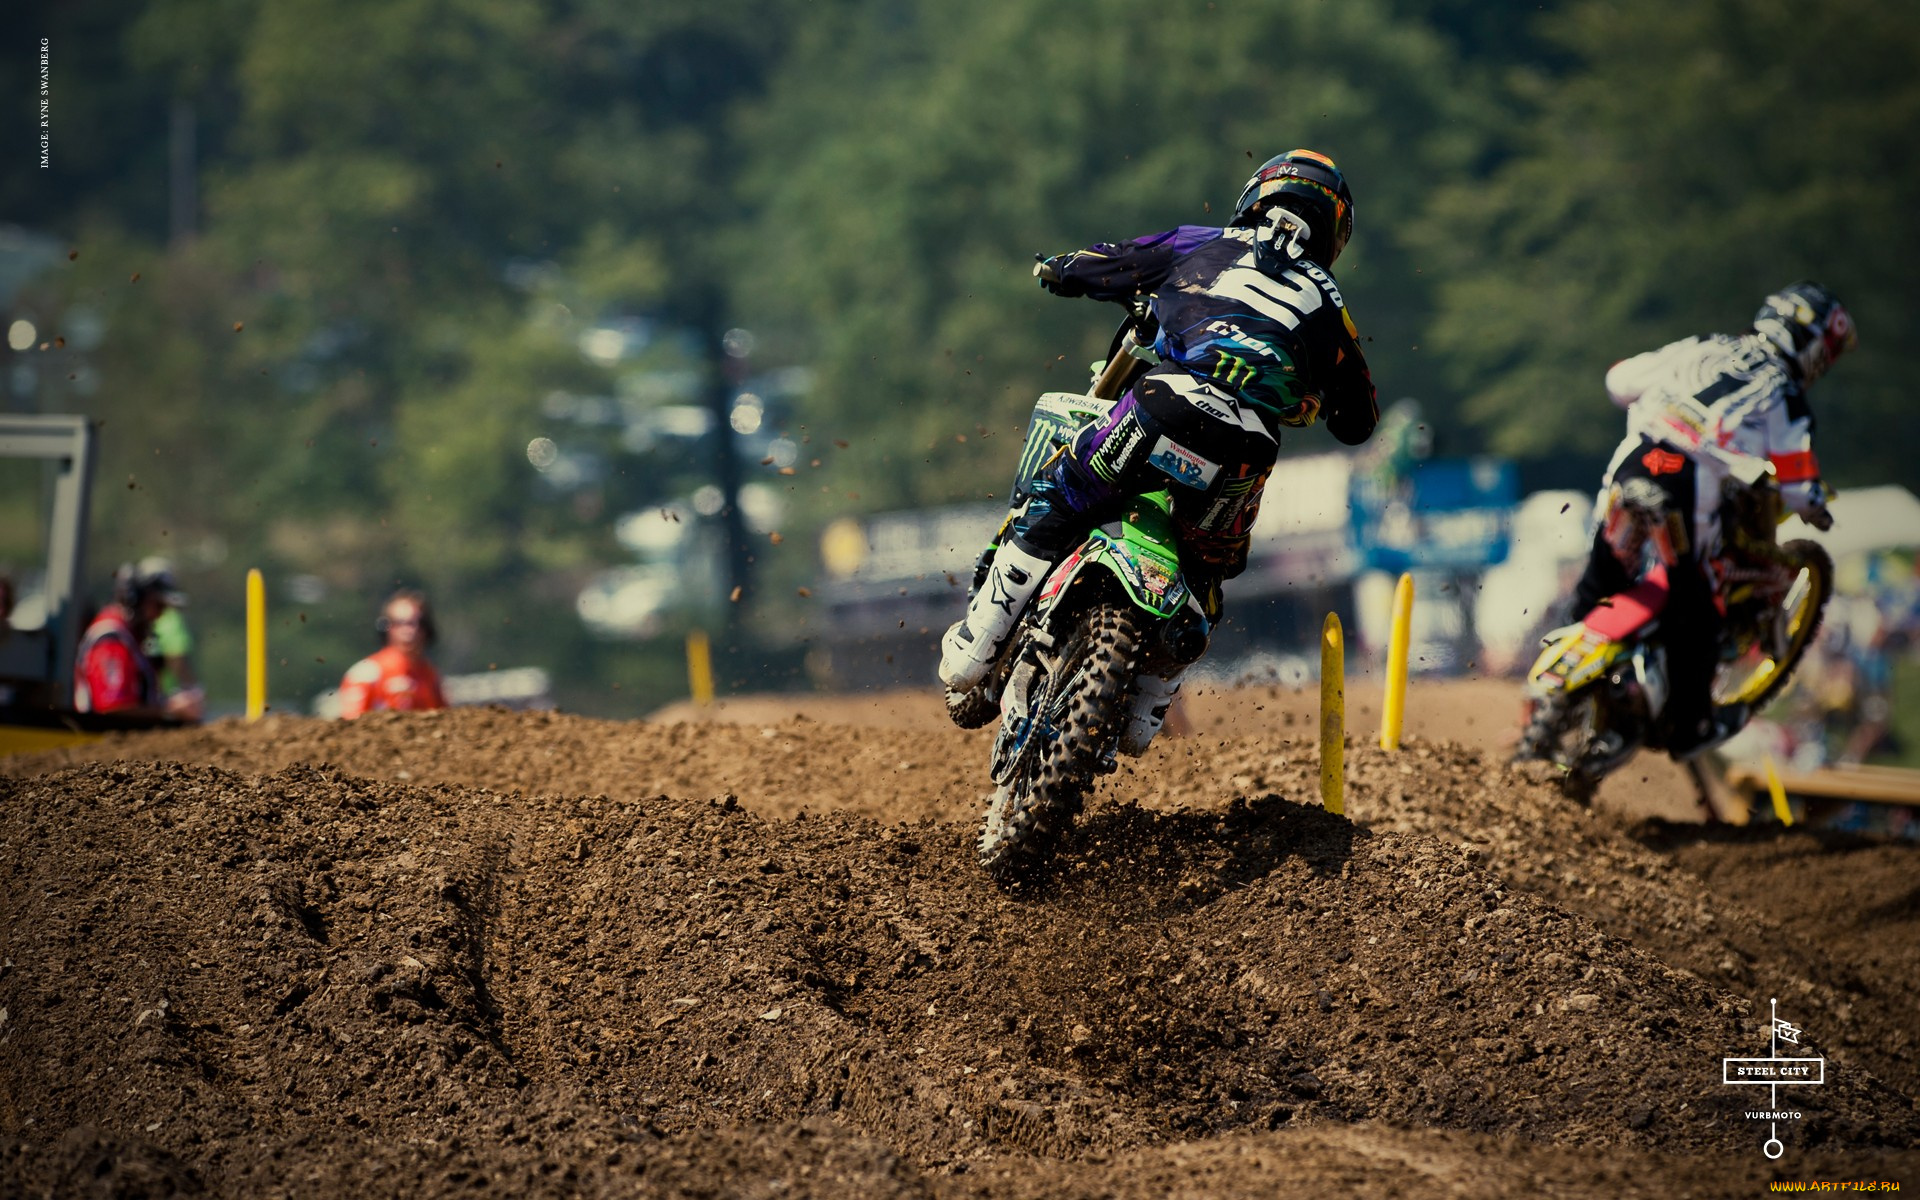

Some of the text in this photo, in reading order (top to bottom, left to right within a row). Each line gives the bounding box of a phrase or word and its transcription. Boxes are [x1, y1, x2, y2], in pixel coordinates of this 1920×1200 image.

[1195, 400, 1230, 419] thor
[1099, 410, 1135, 457] MONSTER
[1110, 426, 1144, 474] Kawasaki
[1169, 441, 1207, 468] Washington
